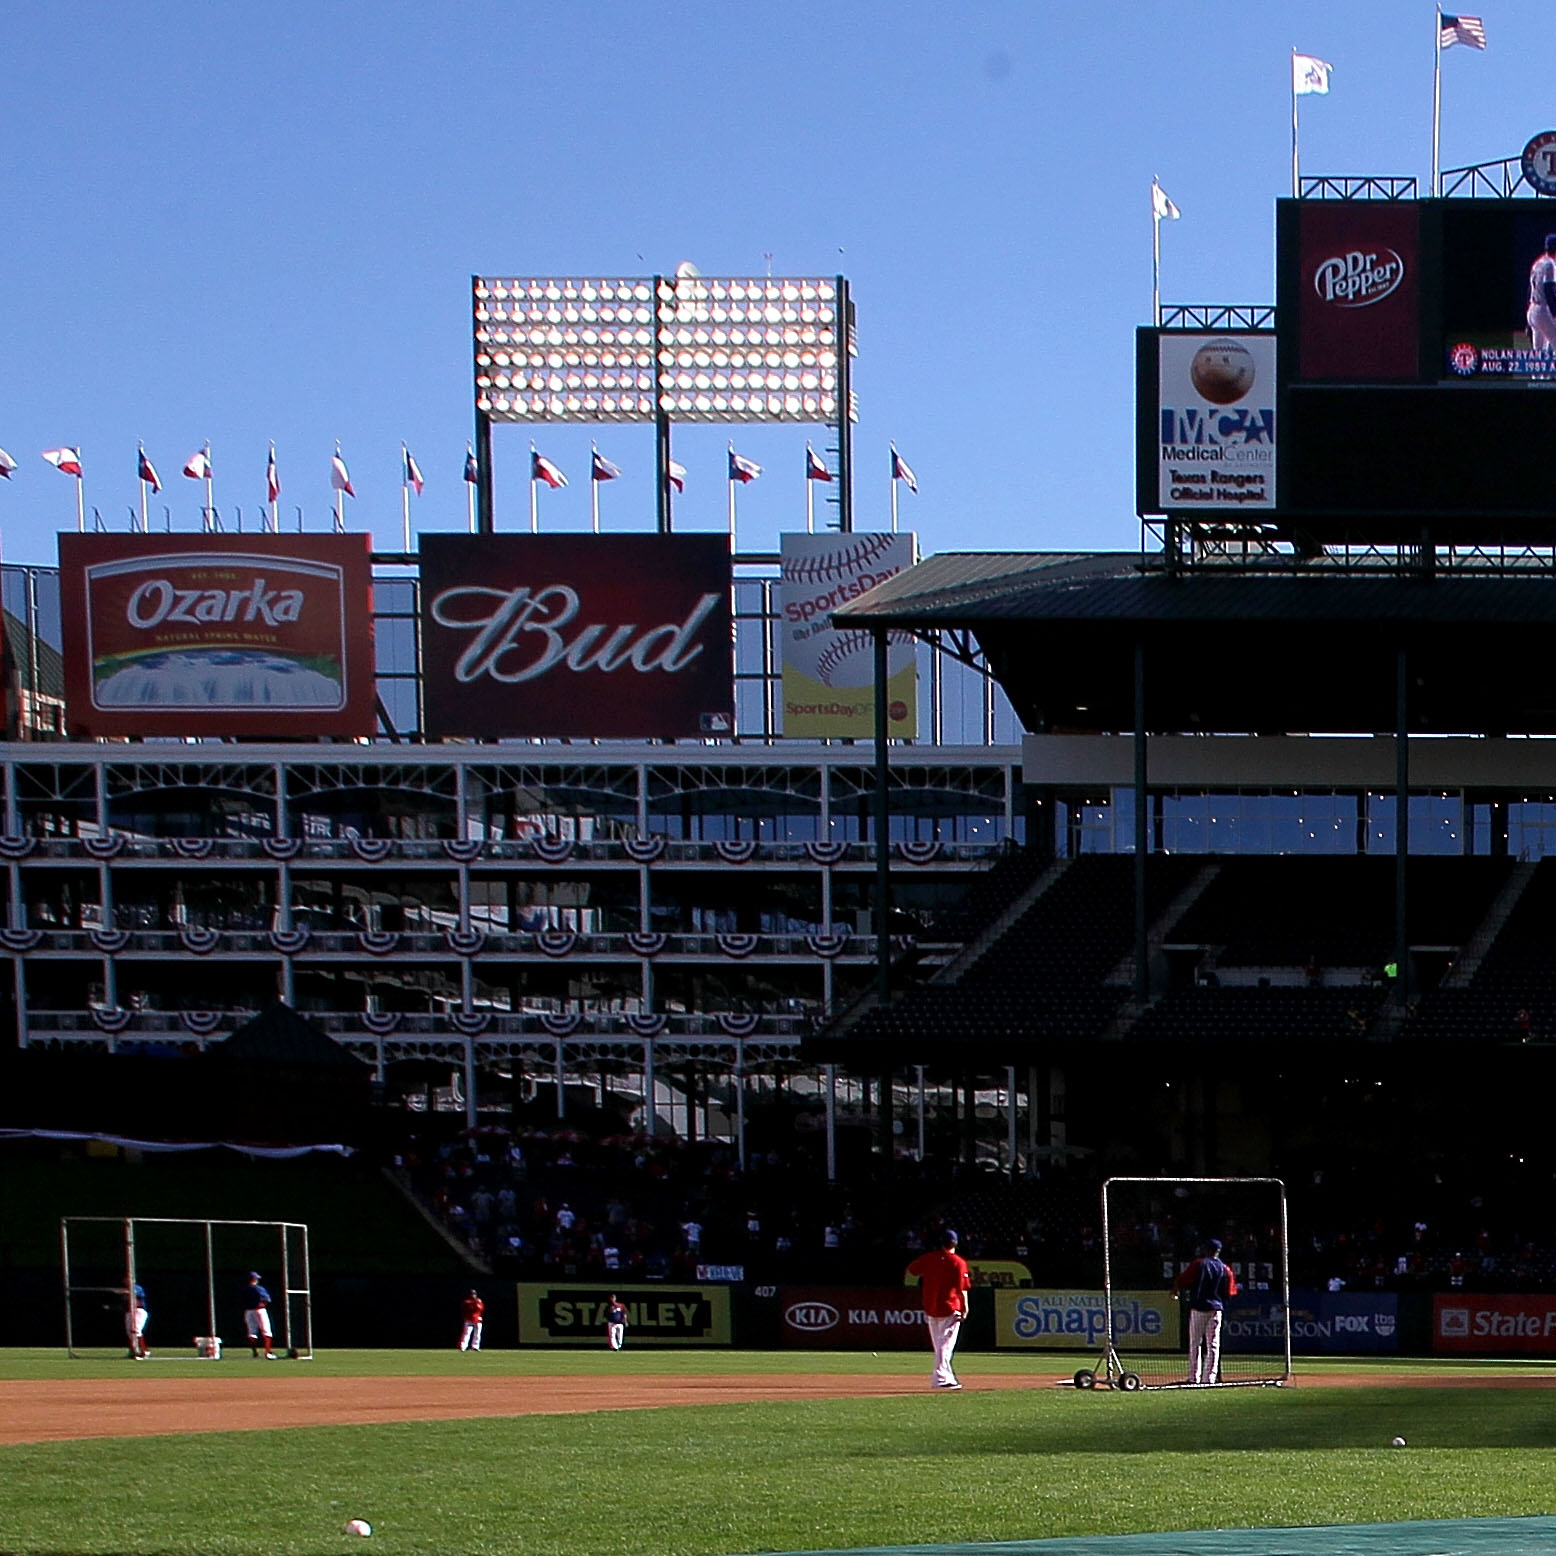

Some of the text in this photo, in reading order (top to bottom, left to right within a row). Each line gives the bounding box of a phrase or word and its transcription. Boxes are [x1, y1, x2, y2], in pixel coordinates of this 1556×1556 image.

[1345, 251, 1377, 277] Dr
[1320, 257, 1397, 301] Pepper
[1481, 349, 1513, 360] NOLAN
[1481, 361, 1505, 372] AUG.
[1161, 409, 1273, 444] MCA
[1169, 470, 1265, 488] Texas Rangers
[127, 578, 305, 630] Ozarka
[430, 583, 722, 684] Bud
[754, 1285, 776, 1299] 407
[793, 1308, 831, 1324] KIA
[847, 1309, 929, 1325] KIA MOT
[1014, 1297, 1161, 1344] Snapple
[1335, 1315, 1370, 1333] FOX
[1222, 1320, 1333, 1337] OSTSESON
